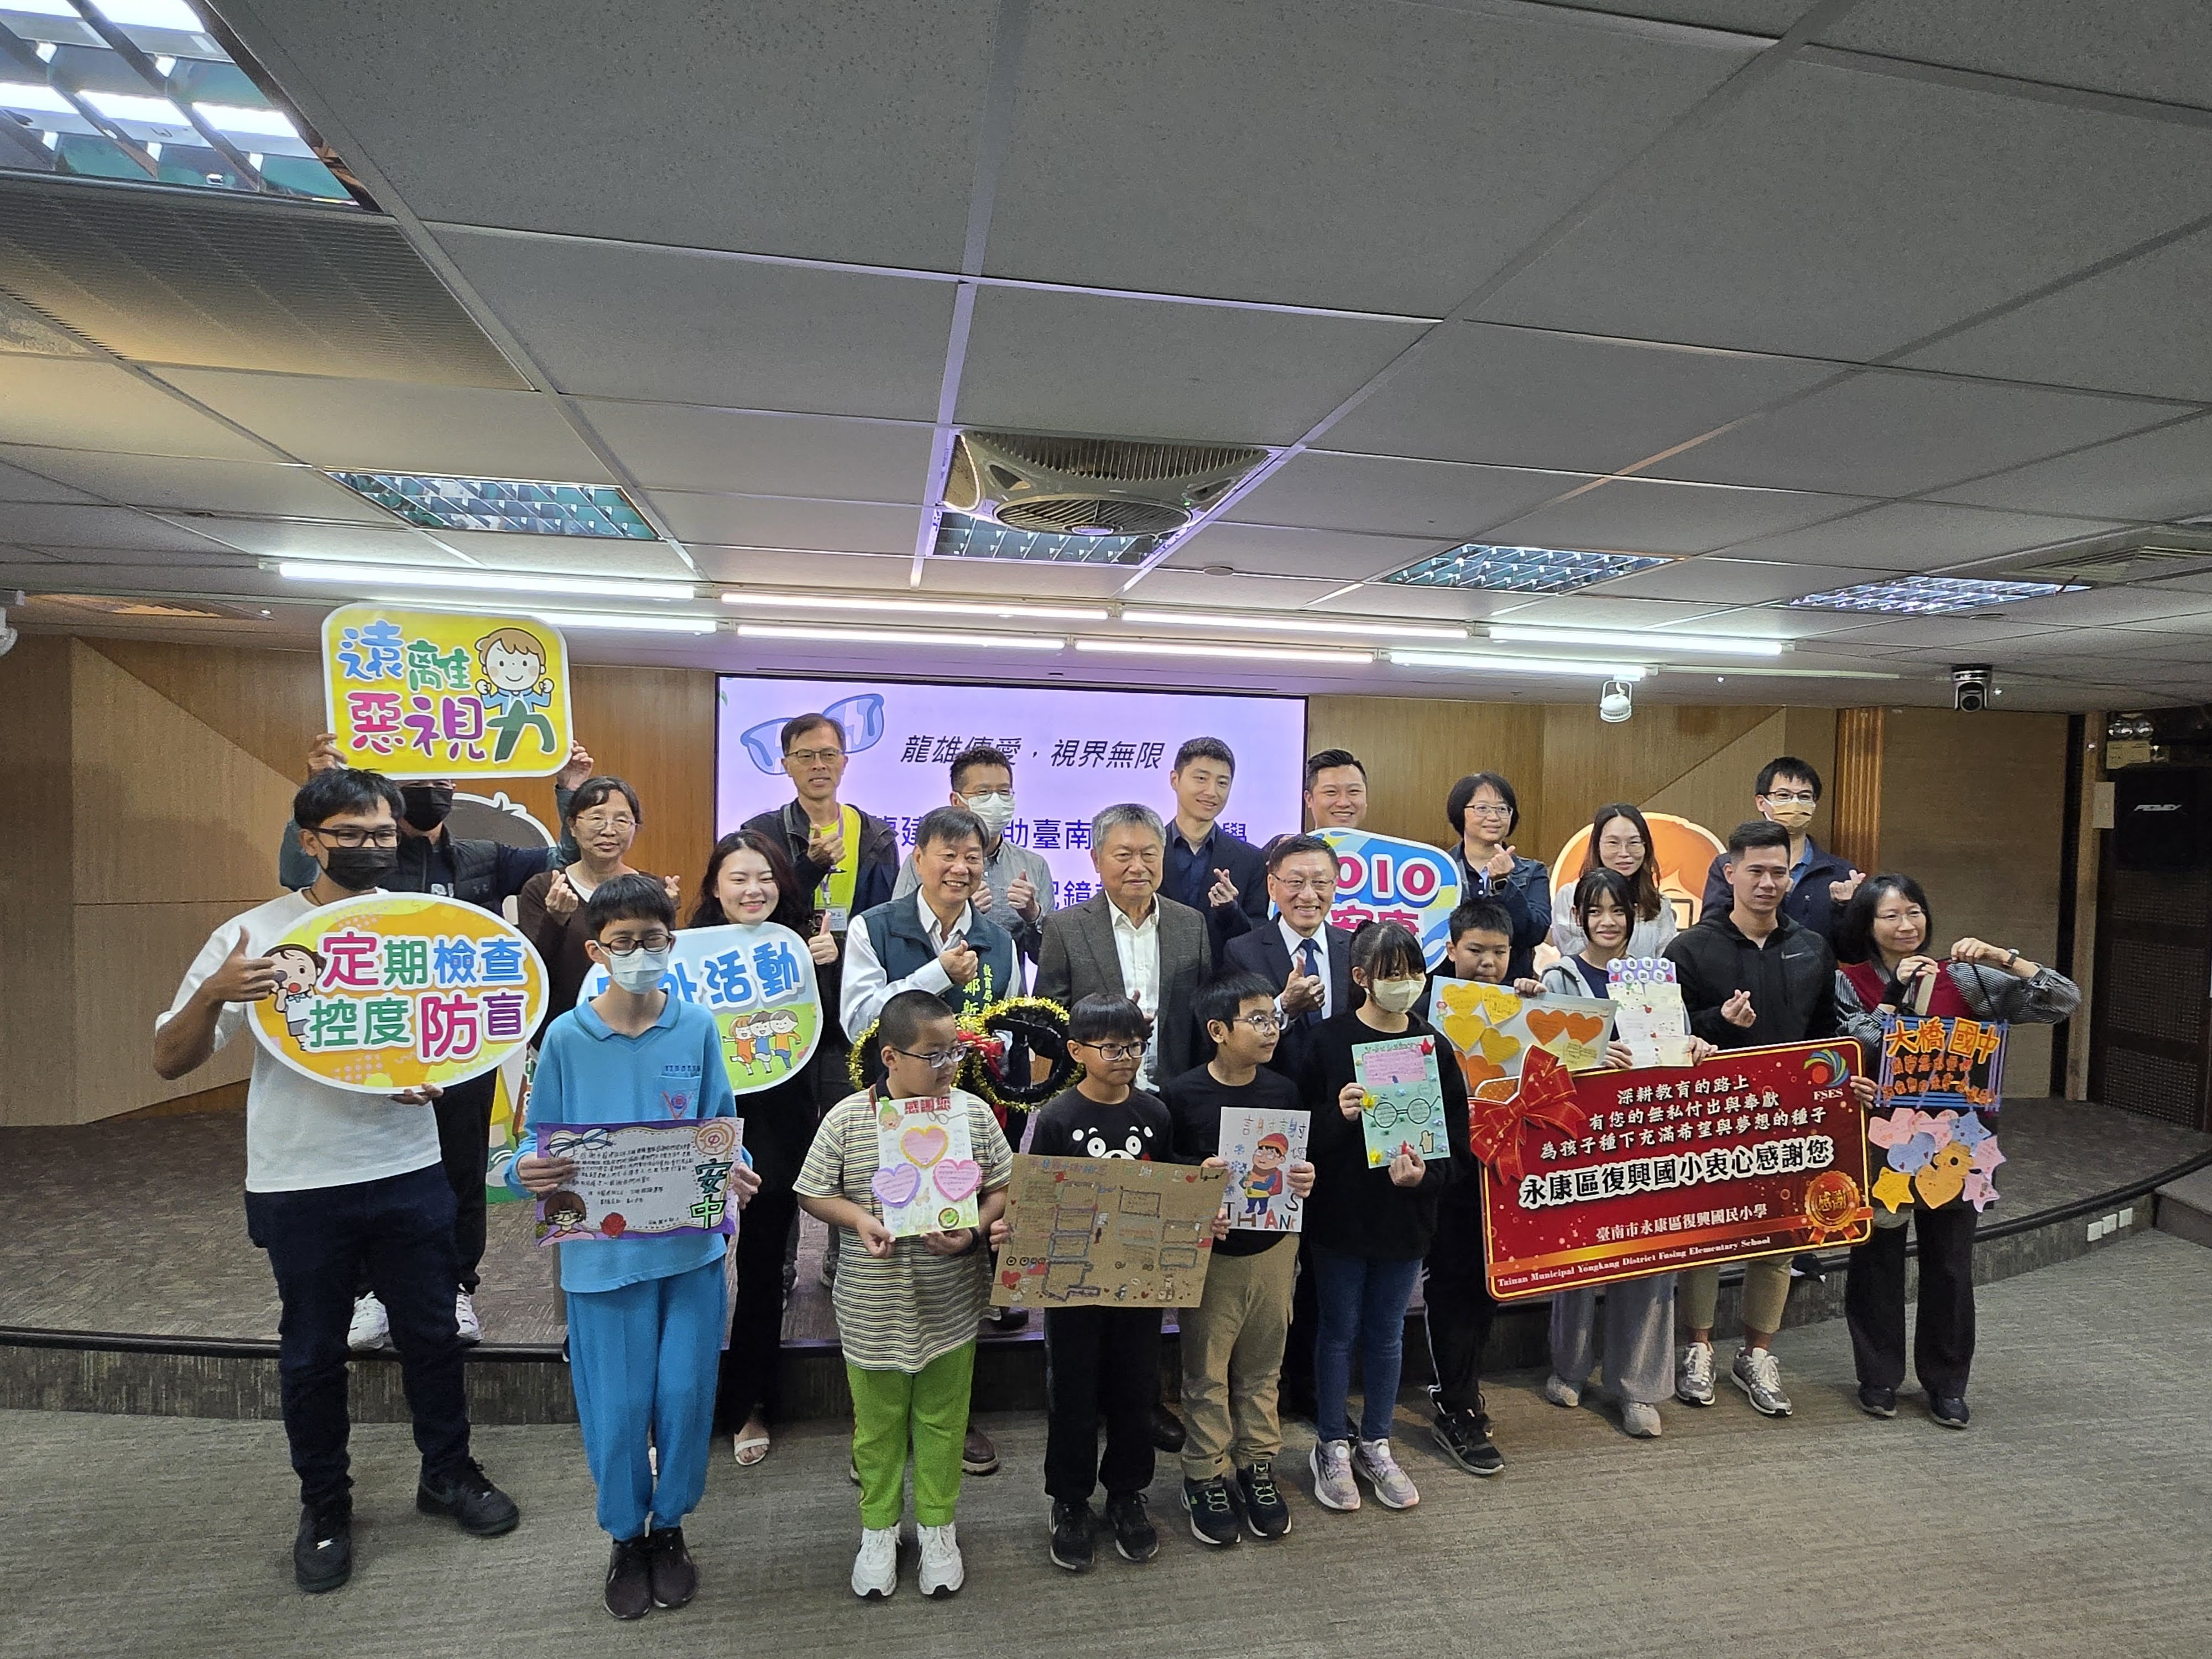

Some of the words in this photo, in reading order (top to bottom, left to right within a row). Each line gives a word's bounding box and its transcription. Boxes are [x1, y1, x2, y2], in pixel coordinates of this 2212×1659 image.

[339, 620, 471, 691] 遠離
[348, 692, 555, 761] 惡視力
[323, 931, 523, 987] 定期檢查
[597, 942, 800, 1004] 外活動
[310, 993, 524, 1058] 控度防盲
[1884, 1016, 2000, 1064] 大橋國中
[1589, 1092, 1780, 1131] 有您的無私付出與奉獻
[1616, 1074, 1750, 1105] 深耕教育的路上
[1813, 1088, 1843, 1100] FSES
[1541, 1107, 1827, 1161] 為孩子種下充滿希望與夢想的種子
[1522, 1139, 1831, 1206] 永康區復興國小衷心感謝您
[1595, 1203, 1767, 1242] 臺南市永康區復興國民小學
[1497, 1275, 1528, 1287] Tainan
[1531, 1267, 1574, 1281] Municipal
[1577, 1260, 1620, 1274] Yongkang
[1623, 1255, 1656, 1266] District
[1658, 1249, 1687, 1260] Fusing
[1689, 1242, 1738, 1255] Elementary
[1741, 1236, 1771, 1248] School
